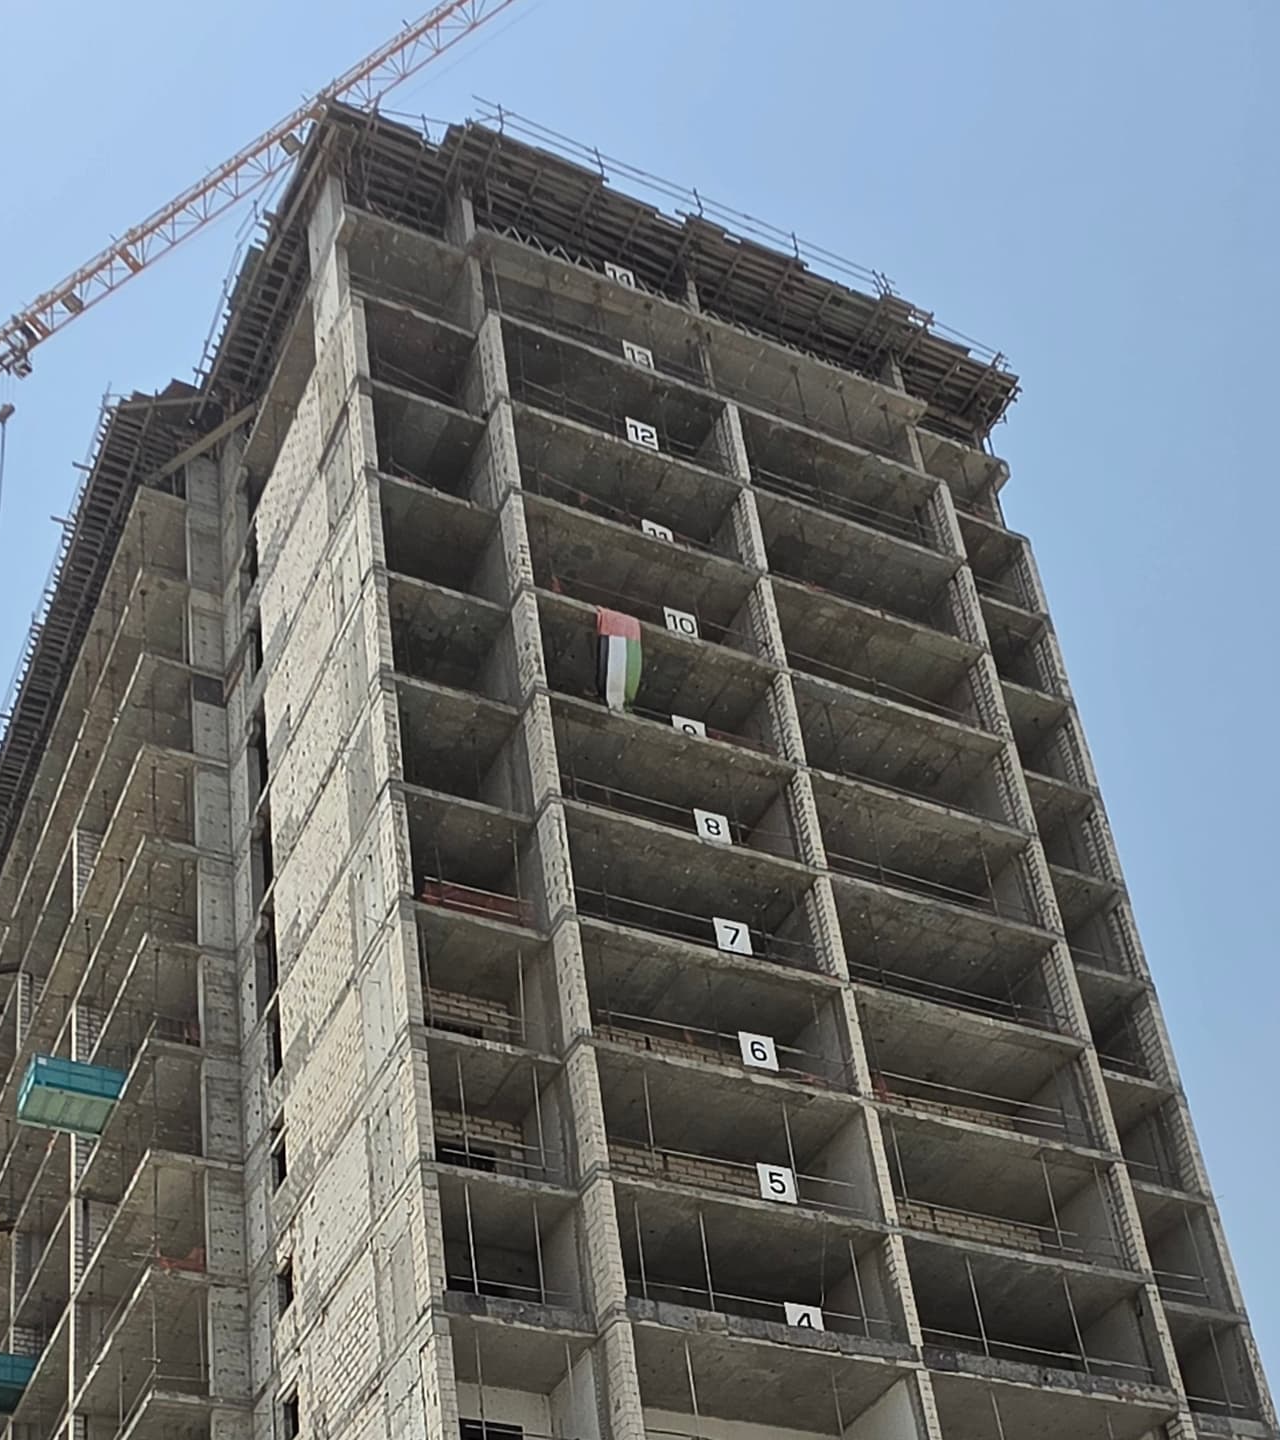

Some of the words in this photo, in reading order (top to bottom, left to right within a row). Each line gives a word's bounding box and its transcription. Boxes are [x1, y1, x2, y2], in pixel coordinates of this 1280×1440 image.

[629, 424, 655, 442] 12
[668, 614, 696, 635] 10
[704, 817, 722, 837] 8
[723, 925, 742, 946] 7
[750, 1042, 769, 1063] 6
[768, 1172, 788, 1195] 5
